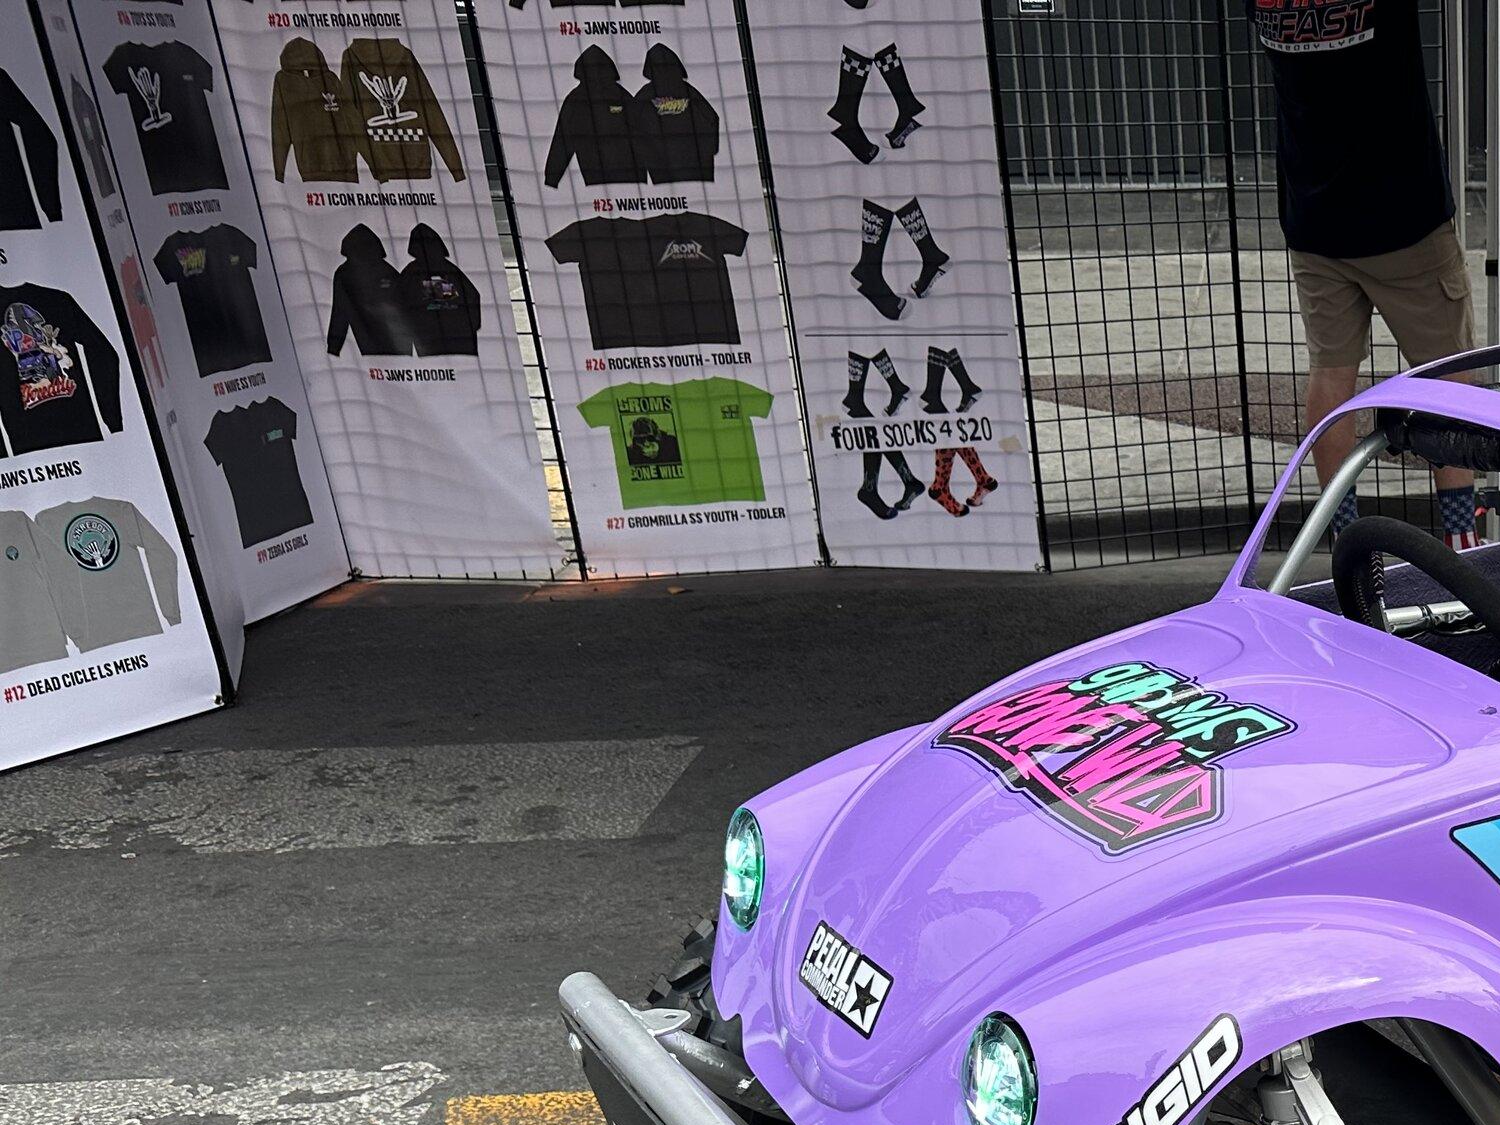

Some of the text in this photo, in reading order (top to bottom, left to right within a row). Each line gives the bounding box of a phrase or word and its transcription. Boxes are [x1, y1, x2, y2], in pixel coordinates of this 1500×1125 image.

[268, 13, 402, 28] #20 ON THE ROAD HOODIE
[560, 20, 661, 35] #24 JAWS HOODIE
[1279, 1, 1374, 41] FAST
[204, 199, 222, 213] YOUTH
[307, 193, 437, 207] #21 ICON RACING HOODIE
[593, 197, 688, 212] #25 WAVE HOODIE
[586, 358, 606, 371] #26
[608, 356, 651, 370] ROCKER
[652, 355, 666, 368] SS
[668, 353, 704, 368] YOUTH
[712, 352, 752, 366] TODLER
[386, 369, 413, 382] JAWS
[415, 369, 455, 382] HOODIE
[619, 397, 673, 413] GROMS
[883, 418, 937, 447] SOCKS
[939, 418, 953, 438] 4
[956, 416, 992, 442] $20
[28, 466, 46, 484] LS
[45, 460, 83, 481] MENS
[606, 517, 625, 531] #27
[627, 513, 687, 529] GROMRILLA
[689, 512, 703, 525] SS
[704, 509, 739, 523] YOUTH
[746, 507, 786, 521] TODLER
[73, 521, 107, 540] SHREDDY
[4, 653, 149, 704] #12 DEAD CICLE LS MENS
[800, 958, 847, 1012] COMMANDER
